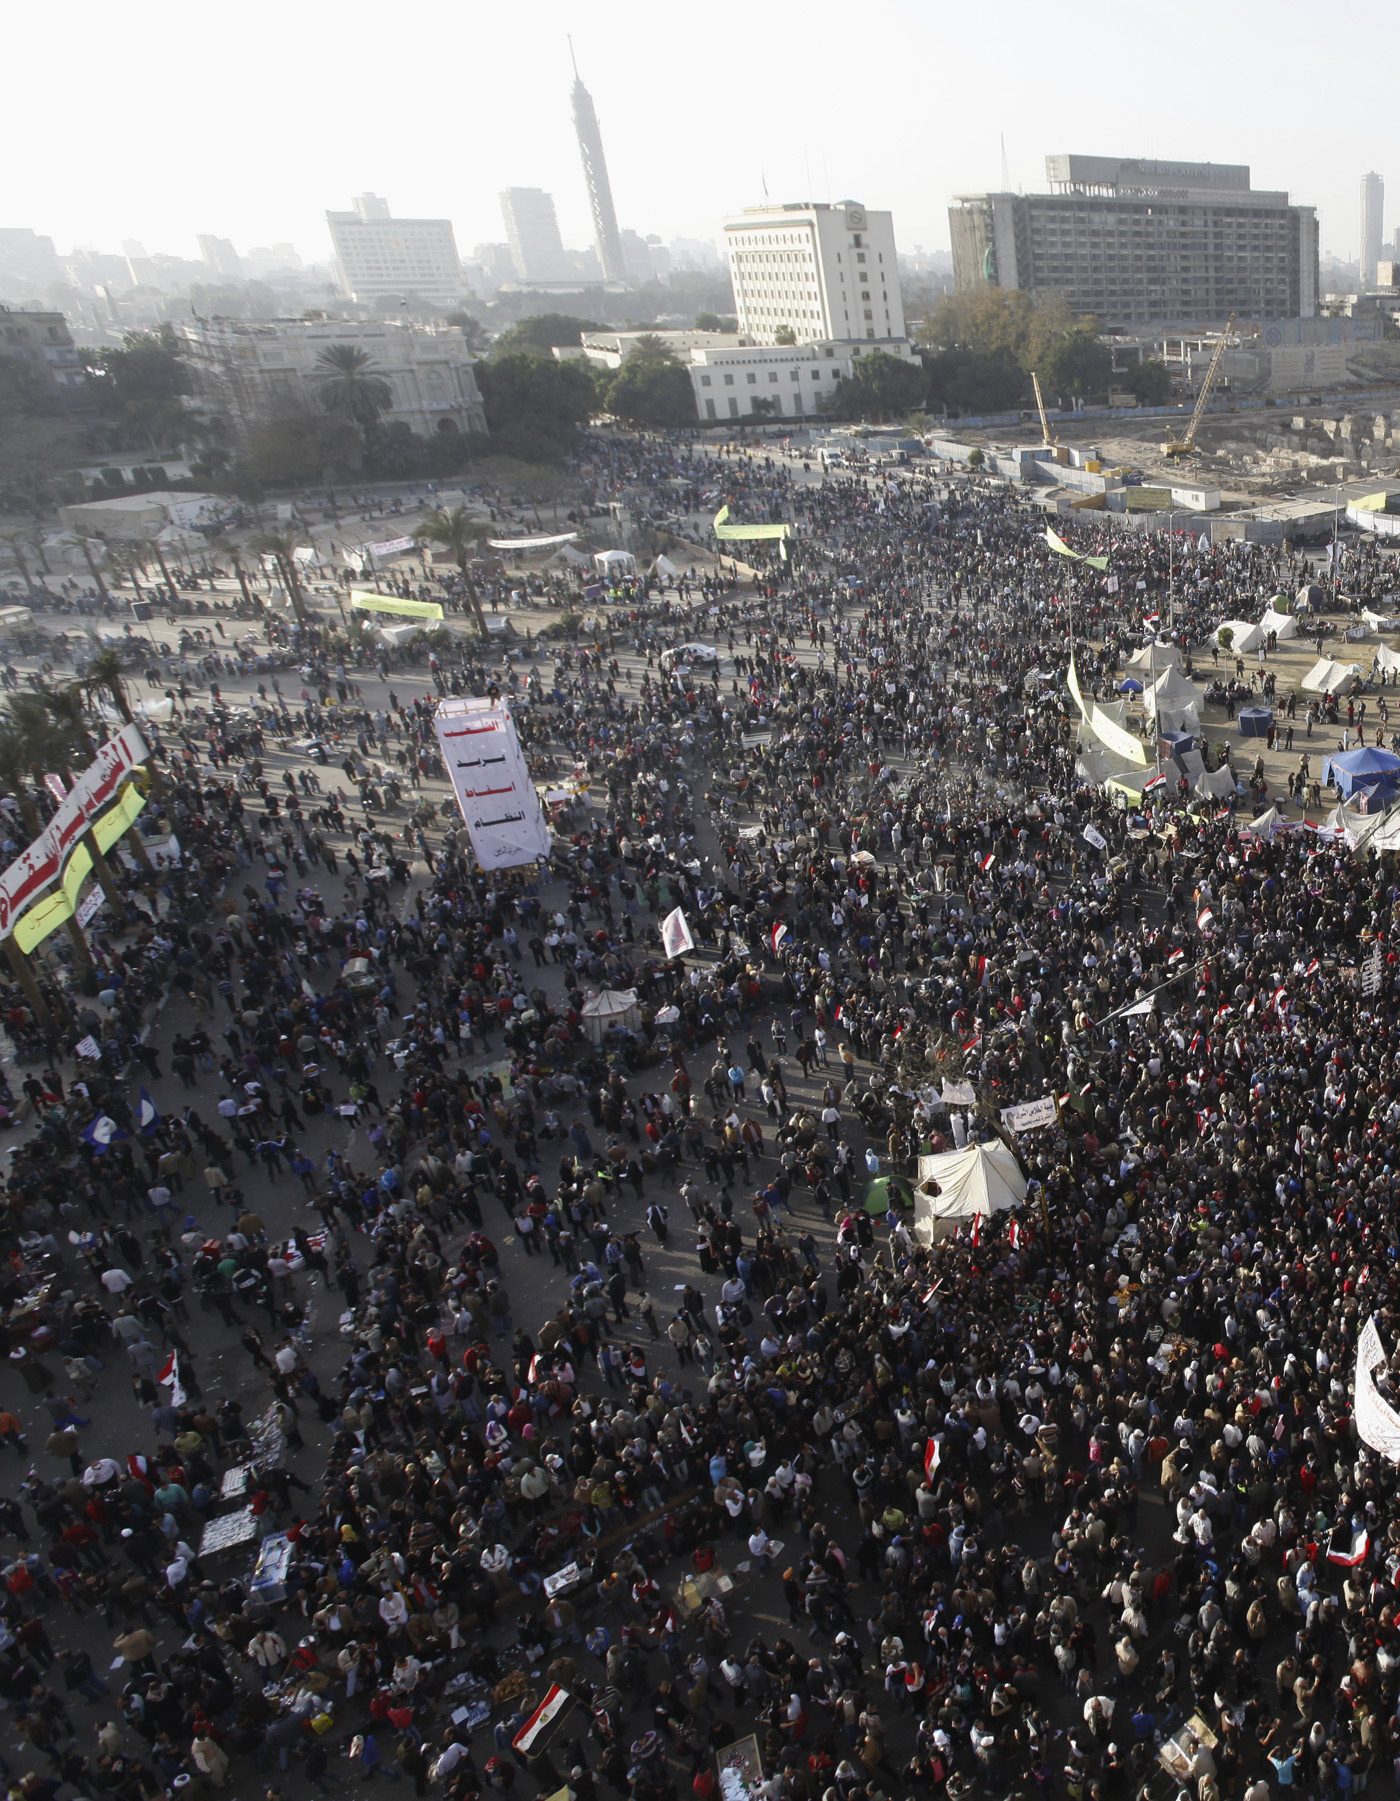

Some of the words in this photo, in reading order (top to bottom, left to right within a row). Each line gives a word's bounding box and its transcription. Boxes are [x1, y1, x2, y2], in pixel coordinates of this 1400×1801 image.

[443, 720, 499, 738] الشعب
[457, 755, 506, 769] يريد
[465, 782, 516, 798] اسقاط
[474, 811, 526, 831] النظام
